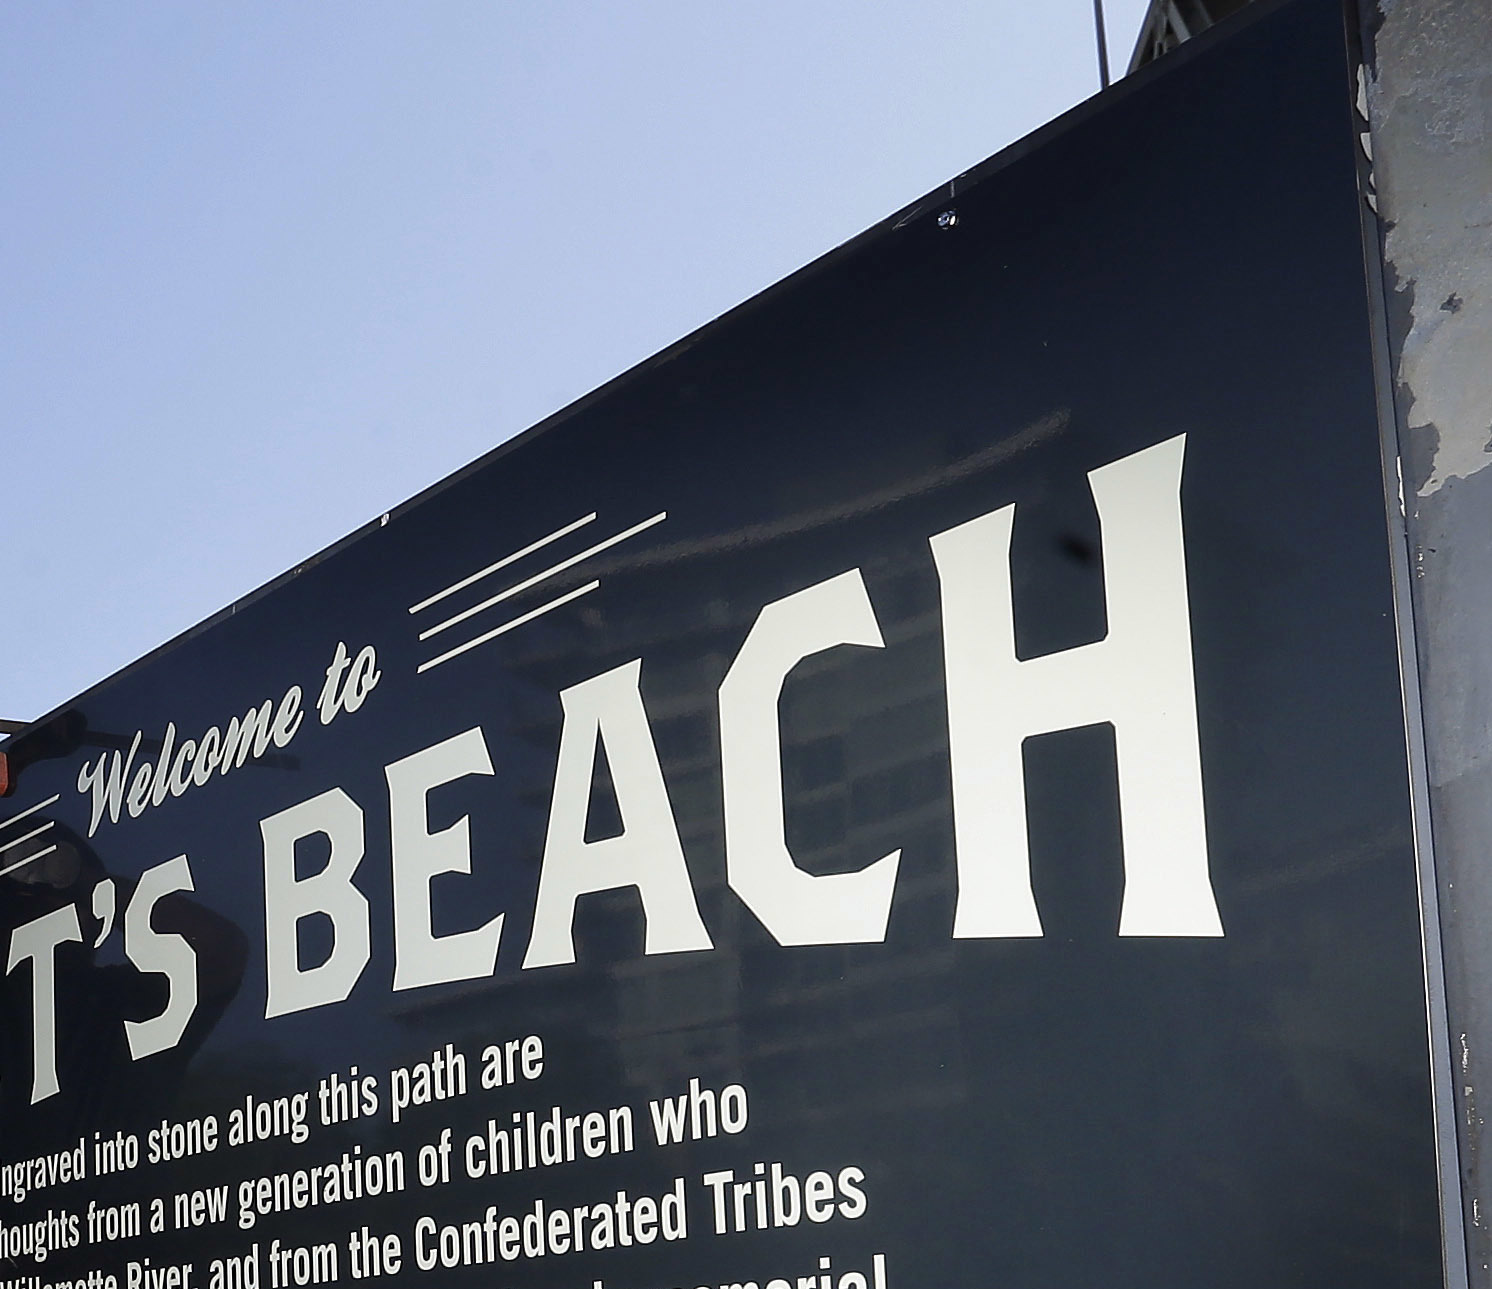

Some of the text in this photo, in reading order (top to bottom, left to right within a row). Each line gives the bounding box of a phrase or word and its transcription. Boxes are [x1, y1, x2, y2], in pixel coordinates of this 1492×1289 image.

[77, 641, 382, 838] Welcome to
[259, 432, 1225, 1020] BEACH
[87, 1200, 141, 1244] from
[150, 1198, 164, 1234] a
[174, 1185, 229, 1229] new
[238, 1145, 405, 1230] generation
[418, 1127, 452, 1187] of
[465, 1106, 634, 1179] children
[649, 1077, 748, 1146] who
[94, 1130, 139, 1176] into
[147, 1115, 218, 1164] stone
[228, 1091, 309, 1147] along
[318, 1065, 378, 1126] this
[391, 1043, 467, 1123] path
[481, 1035, 544, 1090] are
[269, 1239, 338, 1289] from
[348, 1226, 402, 1279] the
[415, 1177, 687, 1271] Confederated
[703, 1162, 867, 1235] Tribes
